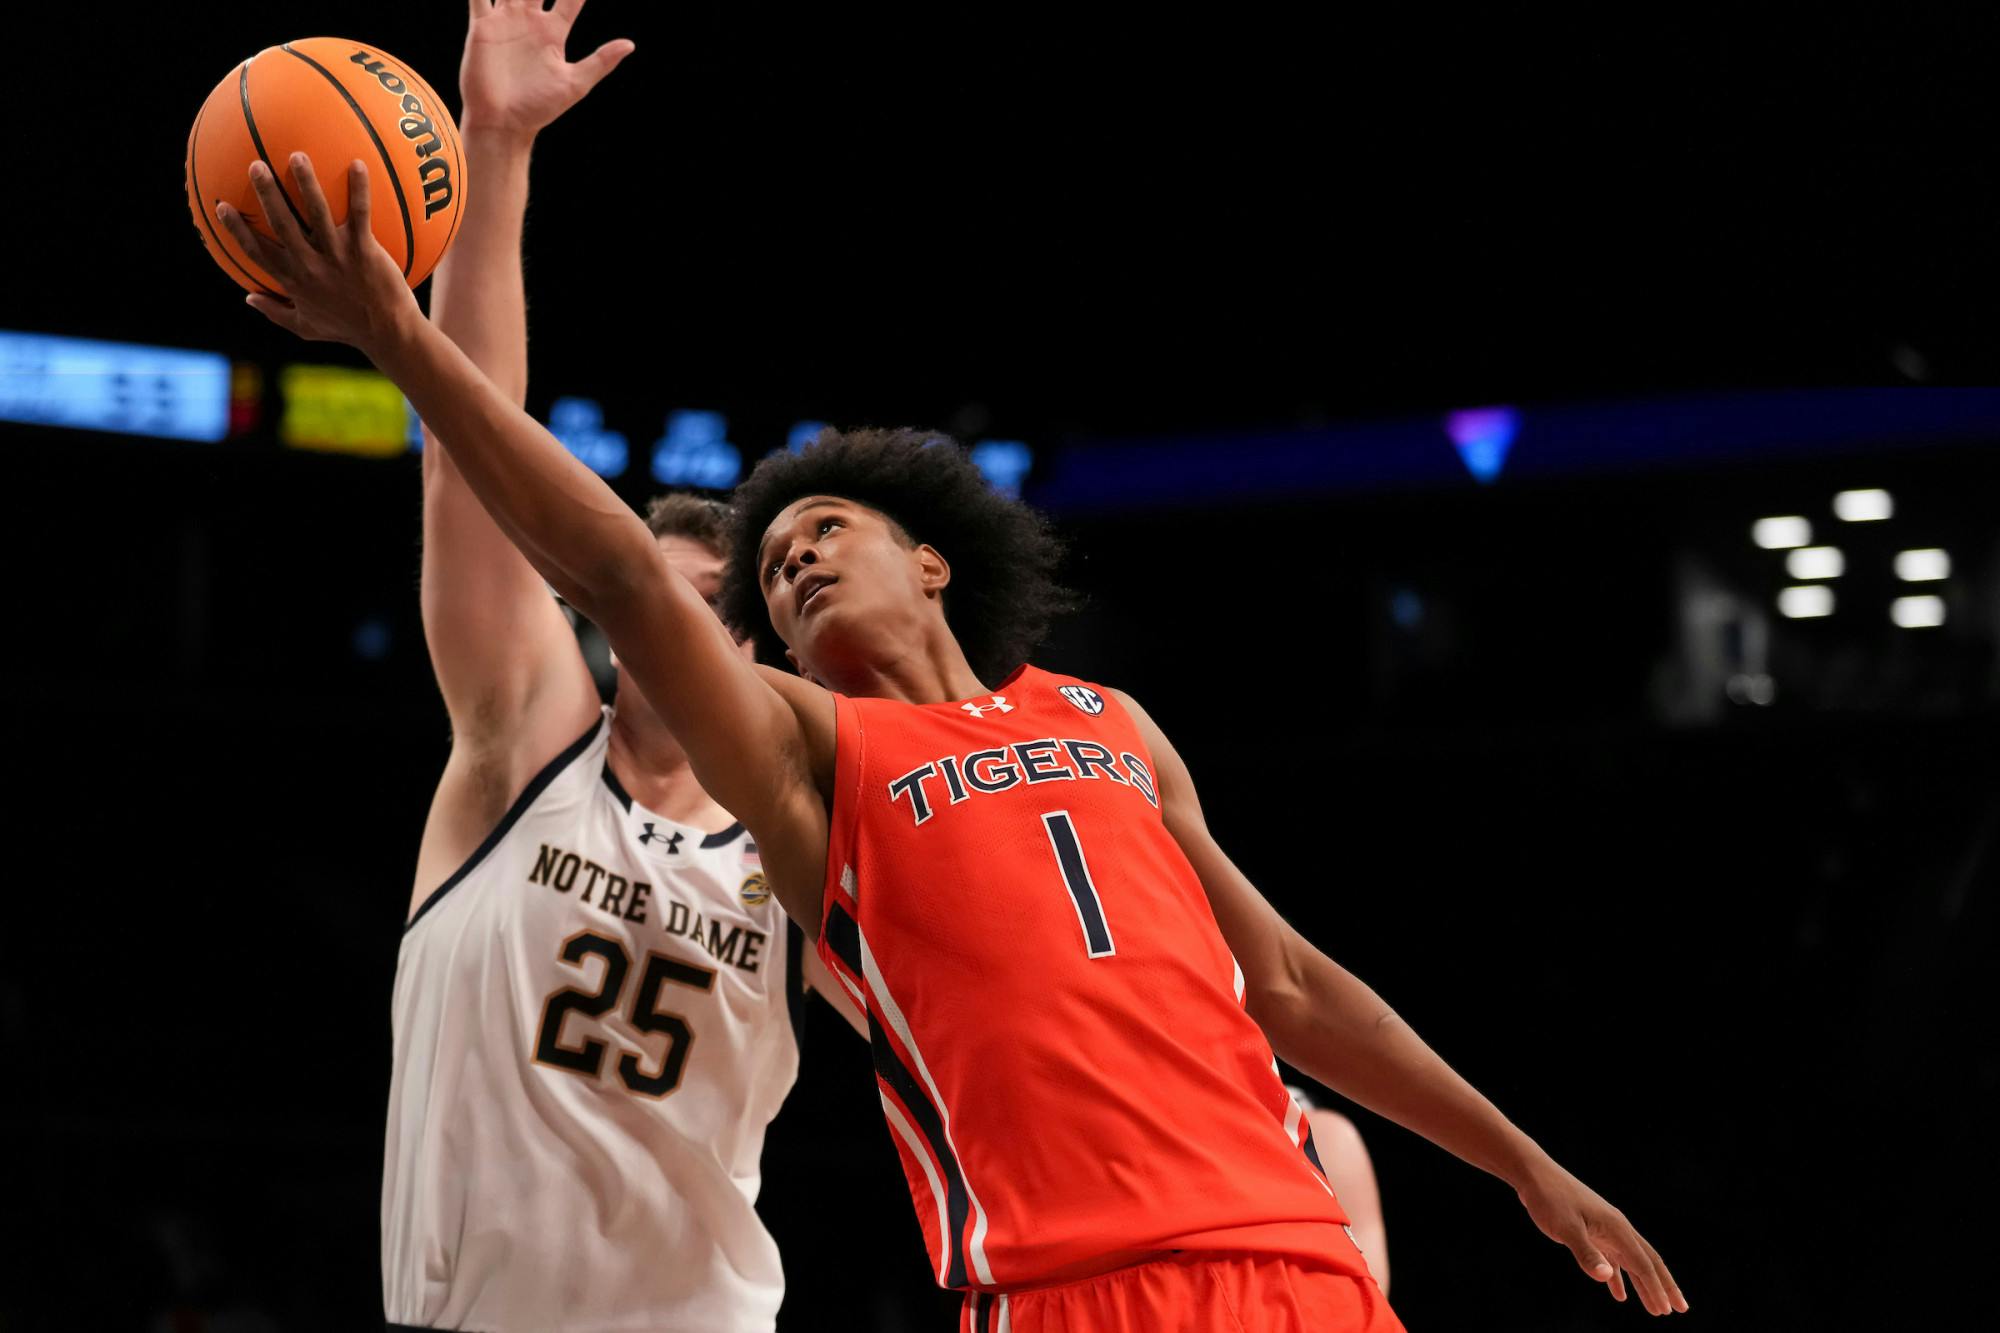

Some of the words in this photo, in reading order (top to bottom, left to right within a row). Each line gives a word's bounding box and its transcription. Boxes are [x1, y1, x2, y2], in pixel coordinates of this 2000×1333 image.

[350, 51, 453, 221] Wilson
[1059, 685, 1102, 714] SEC
[888, 738, 1158, 826] TIGERS
[528, 844, 652, 924] NOTRE
[665, 900, 766, 973] DAME
[1040, 810, 1116, 959] 1
[531, 928, 718, 1101] 25
